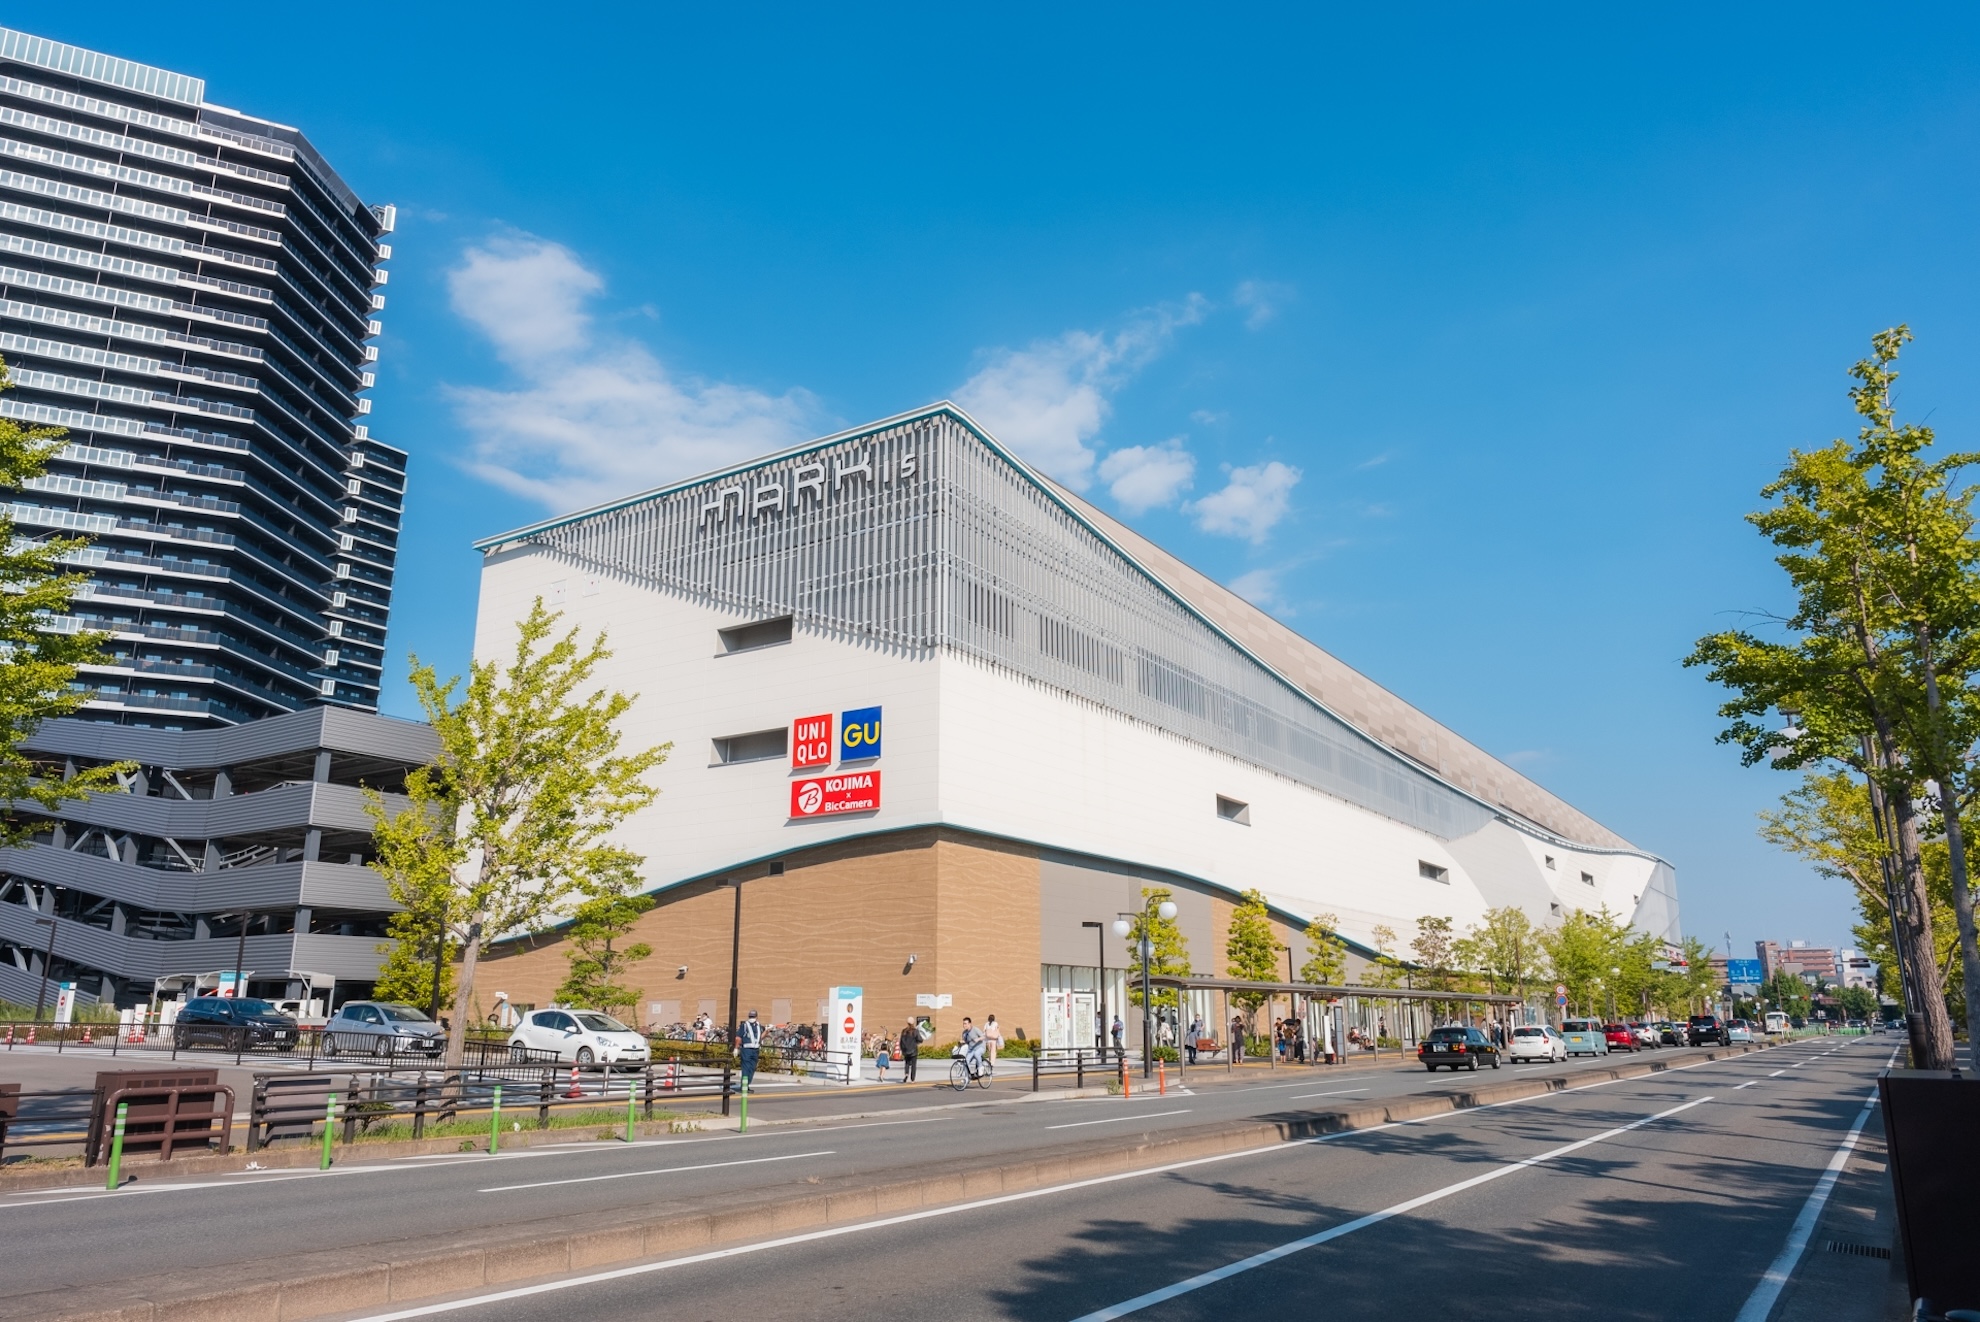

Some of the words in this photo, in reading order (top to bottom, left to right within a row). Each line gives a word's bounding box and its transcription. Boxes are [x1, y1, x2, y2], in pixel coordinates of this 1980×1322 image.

[798, 721, 825, 741] UNI
[843, 721, 880, 747] GU
[797, 742, 827, 764] QLO
[825, 775, 873, 793] KOJIMA
[825, 799, 872, 812] BicCamera
